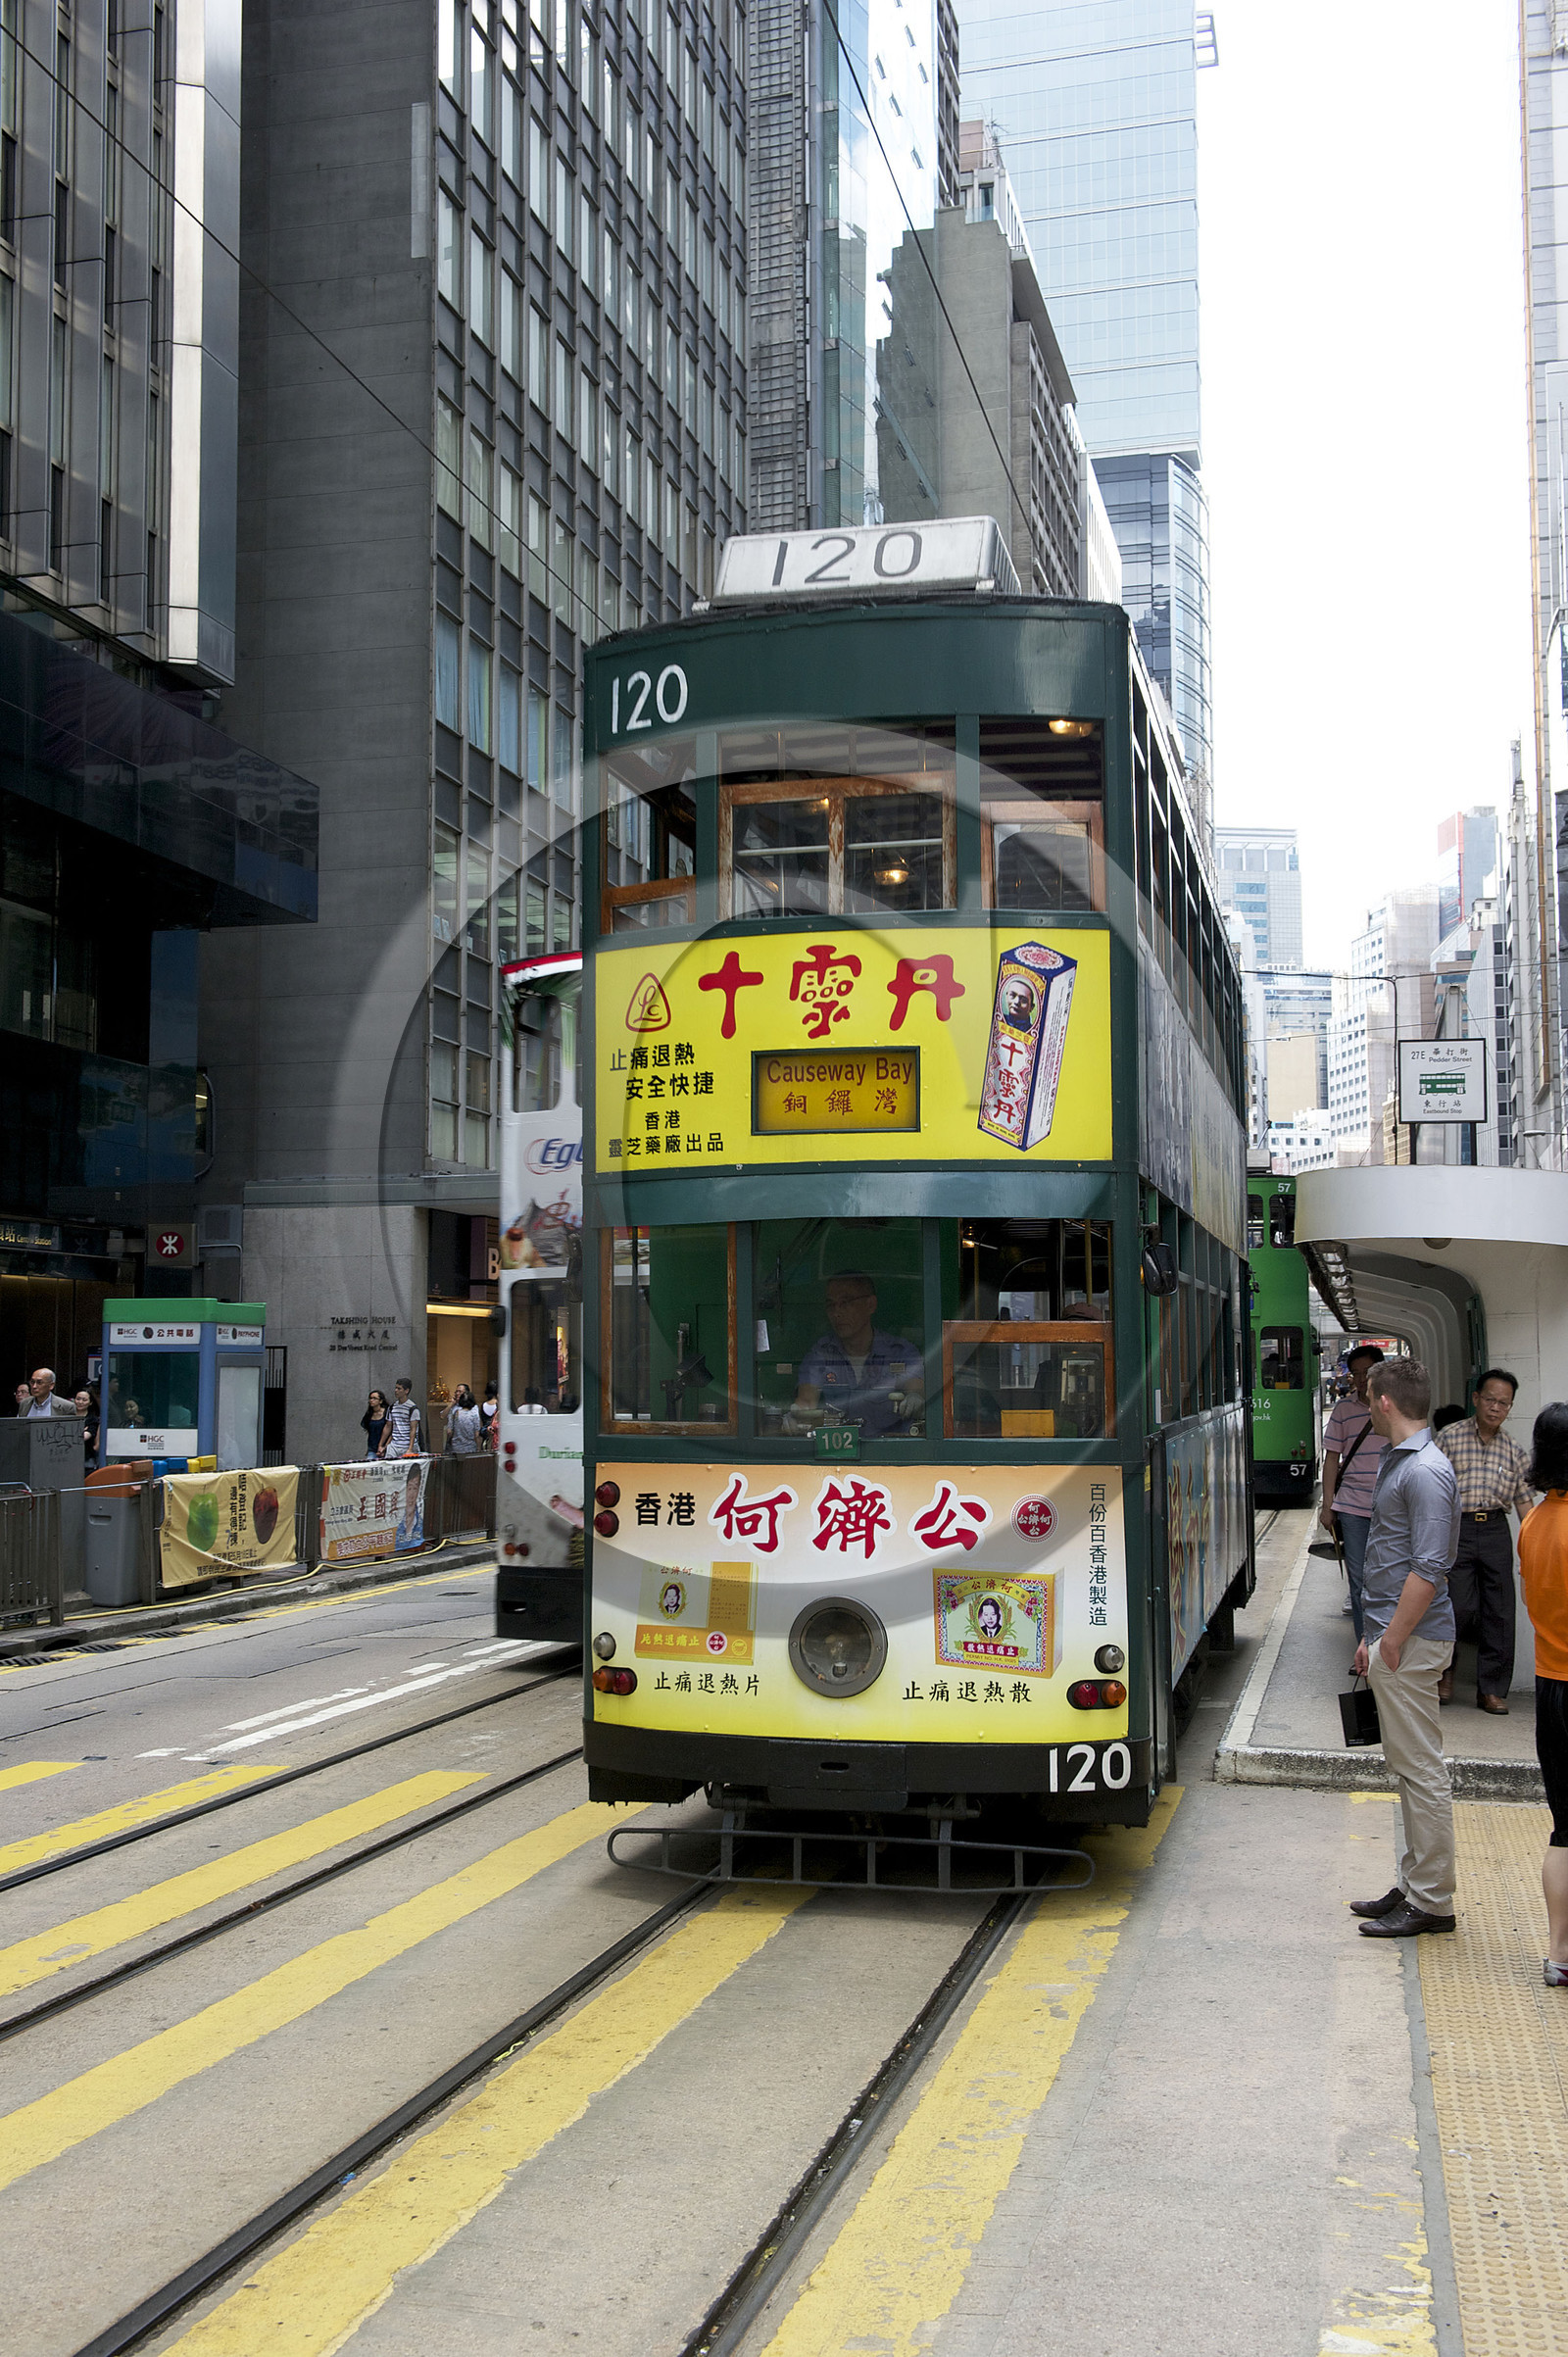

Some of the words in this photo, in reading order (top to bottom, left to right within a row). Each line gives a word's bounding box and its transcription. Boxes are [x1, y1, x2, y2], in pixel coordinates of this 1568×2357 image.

[771, 530, 922, 587] 120
[611, 663, 689, 734] 120
[610, 1042, 695, 1072] 止痛退熱
[1411, 1051, 1426, 1059] 27E
[625, 1071, 714, 1101] 安全快捷
[767, 1059, 866, 1086] Causeway
[876, 1057, 912, 1085] Bay
[783, 1087, 898, 1116] 銅鑼灣
[645, 1109, 680, 1131] 香港
[1278, 1182, 1291, 1193] 57
[157, 1328, 194, 1337] 公共電話
[822, 1431, 854, 1449] 102
[1290, 1464, 1307, 1476] 57
[635, 1492, 696, 1526] 香港
[713, 1478, 987, 1559] 何濟公
[1089, 1483, 1108, 1627] 百份百香港製造
[654, 1671, 760, 1696] 止痛退熱片
[902, 1679, 1033, 1704] 止痛退熱散
[1049, 1742, 1132, 1792] 120
